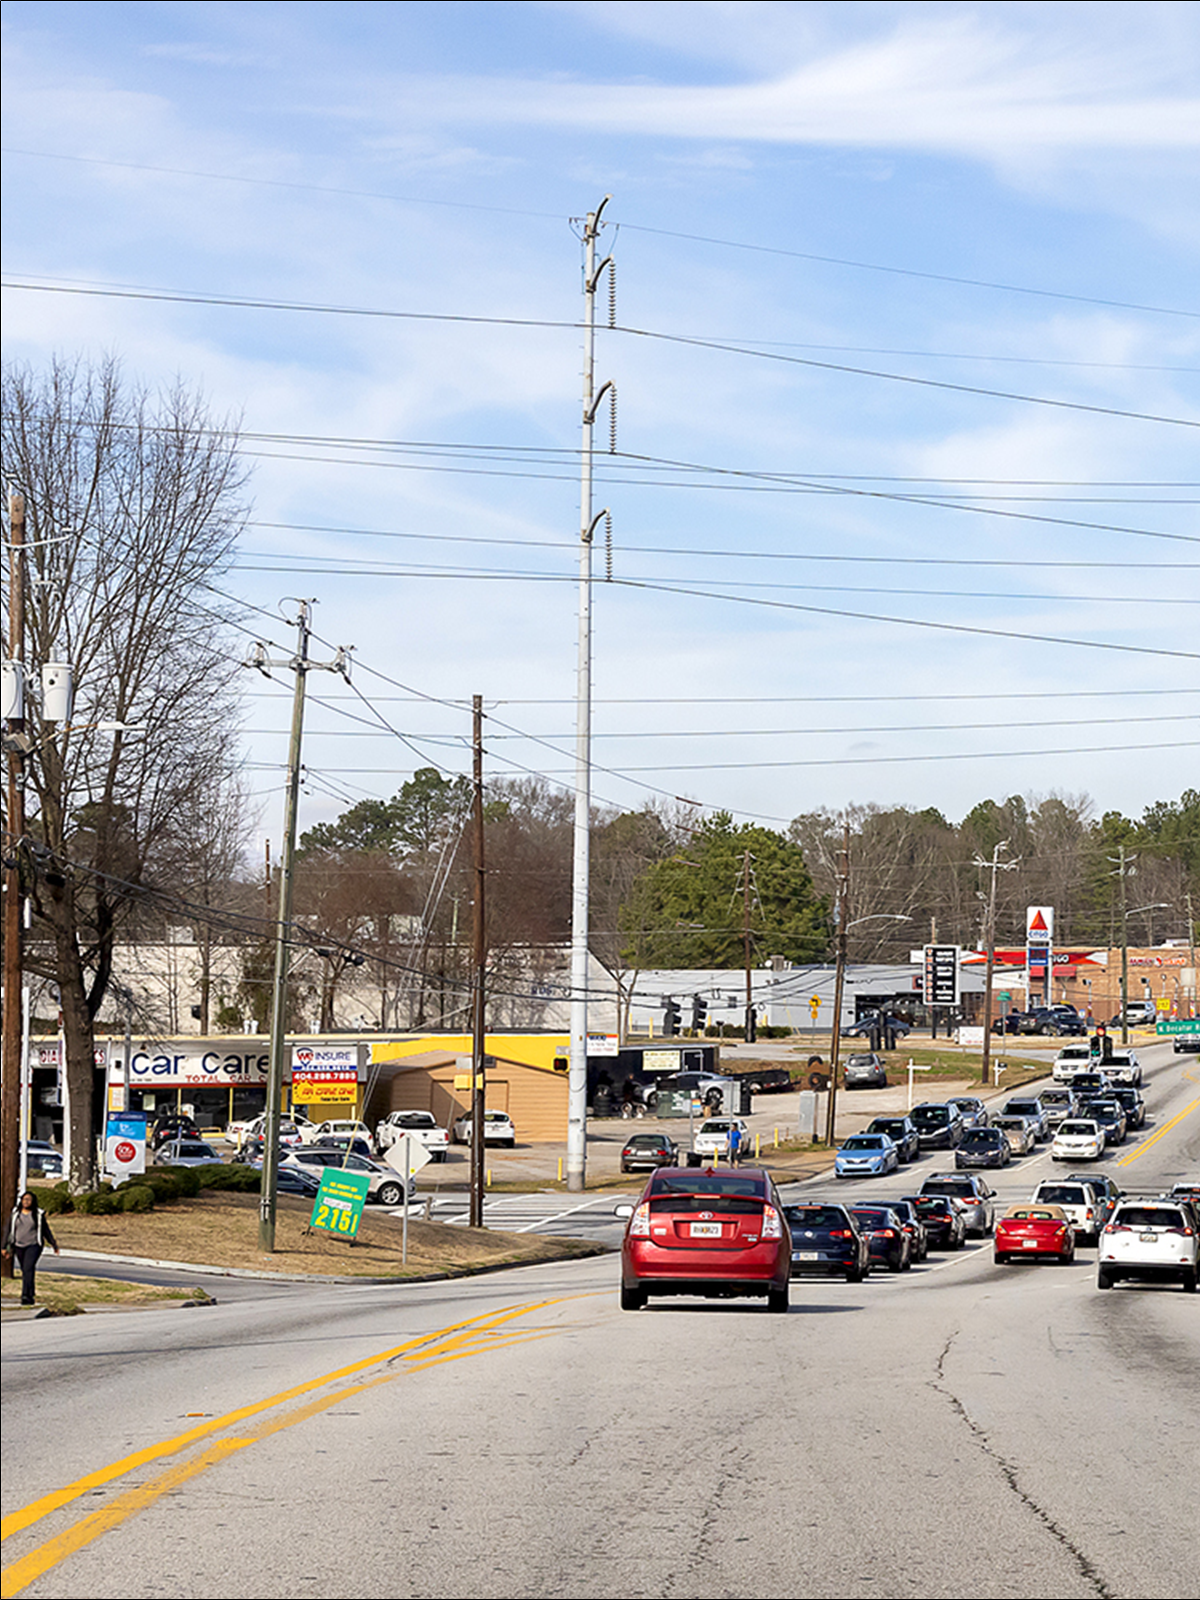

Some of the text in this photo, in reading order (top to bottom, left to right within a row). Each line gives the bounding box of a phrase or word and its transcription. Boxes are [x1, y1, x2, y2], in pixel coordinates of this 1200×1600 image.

[315, 1051, 351, 1061] INSURE
[131, 1052, 186, 1074] Car
[202, 1052, 269, 1074] Care
[185, 1075, 221, 1083] TOTAL
[230, 1075, 251, 1083] CAR
